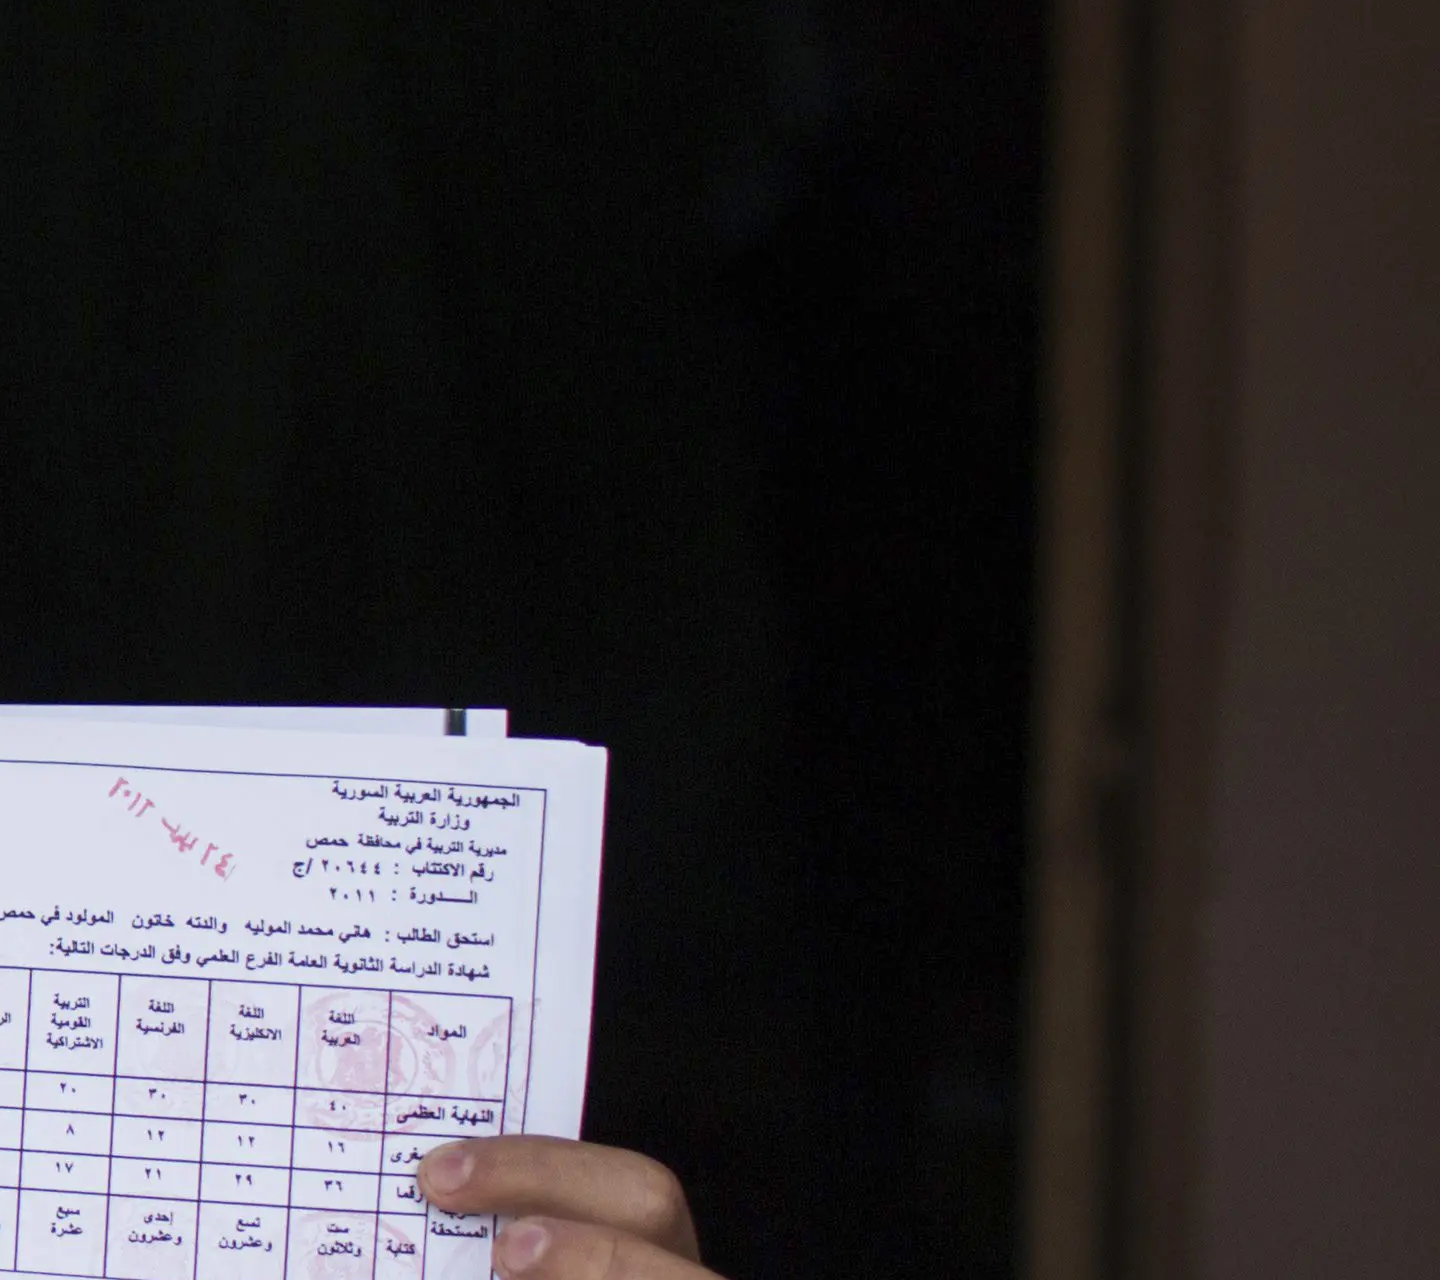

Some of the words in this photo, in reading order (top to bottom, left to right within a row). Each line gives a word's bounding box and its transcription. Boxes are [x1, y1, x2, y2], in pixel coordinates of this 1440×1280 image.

[332, 781, 387, 800] السورية
[394, 784, 441, 804] العربية
[448, 788, 520, 807] الجمهورية
[379, 807, 423, 826] التربية
[430, 812, 470, 830] وزارة
[306, 834, 348, 848] حمص
[358, 834, 401, 850] محافظة
[406, 837, 421, 854] في
[426, 838, 463, 854] التربية
[469, 842, 506, 857] مديرية
[412, 863, 464, 877] الاكتتاب
[470, 867, 494, 881] رقم
[330, 888, 375, 902] ٢٠١١
[41, 906, 59, 926] في
[65, 911, 114, 925] المولود
[132, 914, 175, 930] خاتون
[186, 917, 227, 934] والدته
[298, 925, 333, 935] محمد
[339, 925, 371, 943] هاني
[397, 930, 440, 943] الطالب
[447, 931, 494, 948] استحق
[101, 945, 156, 960] الدرجات
[161, 946, 191, 963] وفق
[196, 951, 239, 966] العلمي
[288, 952, 327, 969] العامة
[246, 952, 282, 970] الفرع
[334, 954, 383, 972] الثانوية
[390, 959, 442, 976] الدراسة
[448, 963, 490, 981] شهادة
[53, 993, 90, 1009] التربية
[148, 999, 174, 1013] اللغة
[238, 1005, 264, 1019] اللغة
[51, 1013, 91, 1028] القومية
[136, 1019, 184, 1034] الفرنسية
[321, 1030, 360, 1047] العربية
[427, 1025, 466, 1040] المواد
[452, 1108, 494, 1124] النهاية
[51, 1222, 83, 1237] عشرة
[129, 1230, 182, 1245] وعشرون
[431, 1222, 488, 1238] المستحقة
[218, 1236, 273, 1252] وعشرون
[317, 1241, 361, 1257] وثلاثون
